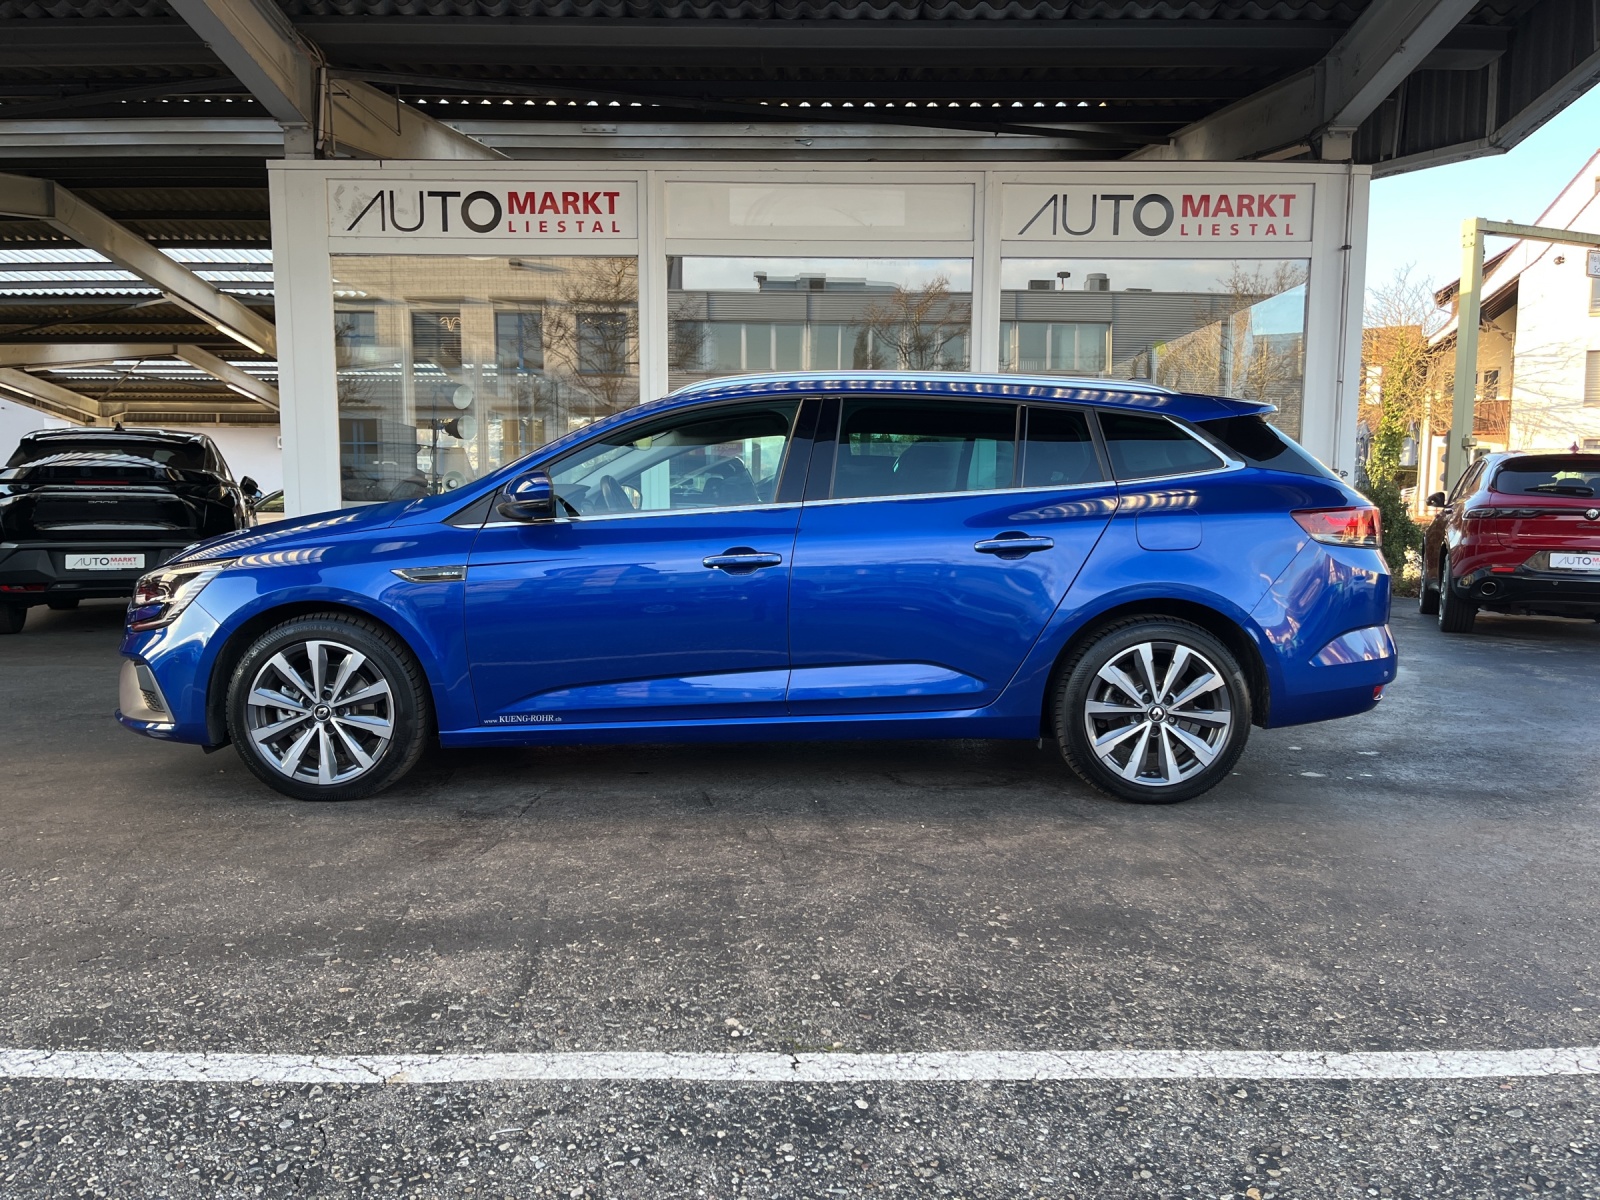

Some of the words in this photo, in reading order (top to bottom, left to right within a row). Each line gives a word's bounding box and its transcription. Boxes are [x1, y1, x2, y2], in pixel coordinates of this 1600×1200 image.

[347, 190, 502, 233] AUTO
[507, 191, 620, 215] MARKT
[1017, 193, 1174, 236] AUTO
[1181, 194, 1296, 218] MARKT
[507, 220, 620, 233] LIESTAL
[1180, 223, 1294, 236] LIESTAL
[73, 557, 110, 566] AUTO
[1557, 556, 1592, 566] AUTO
